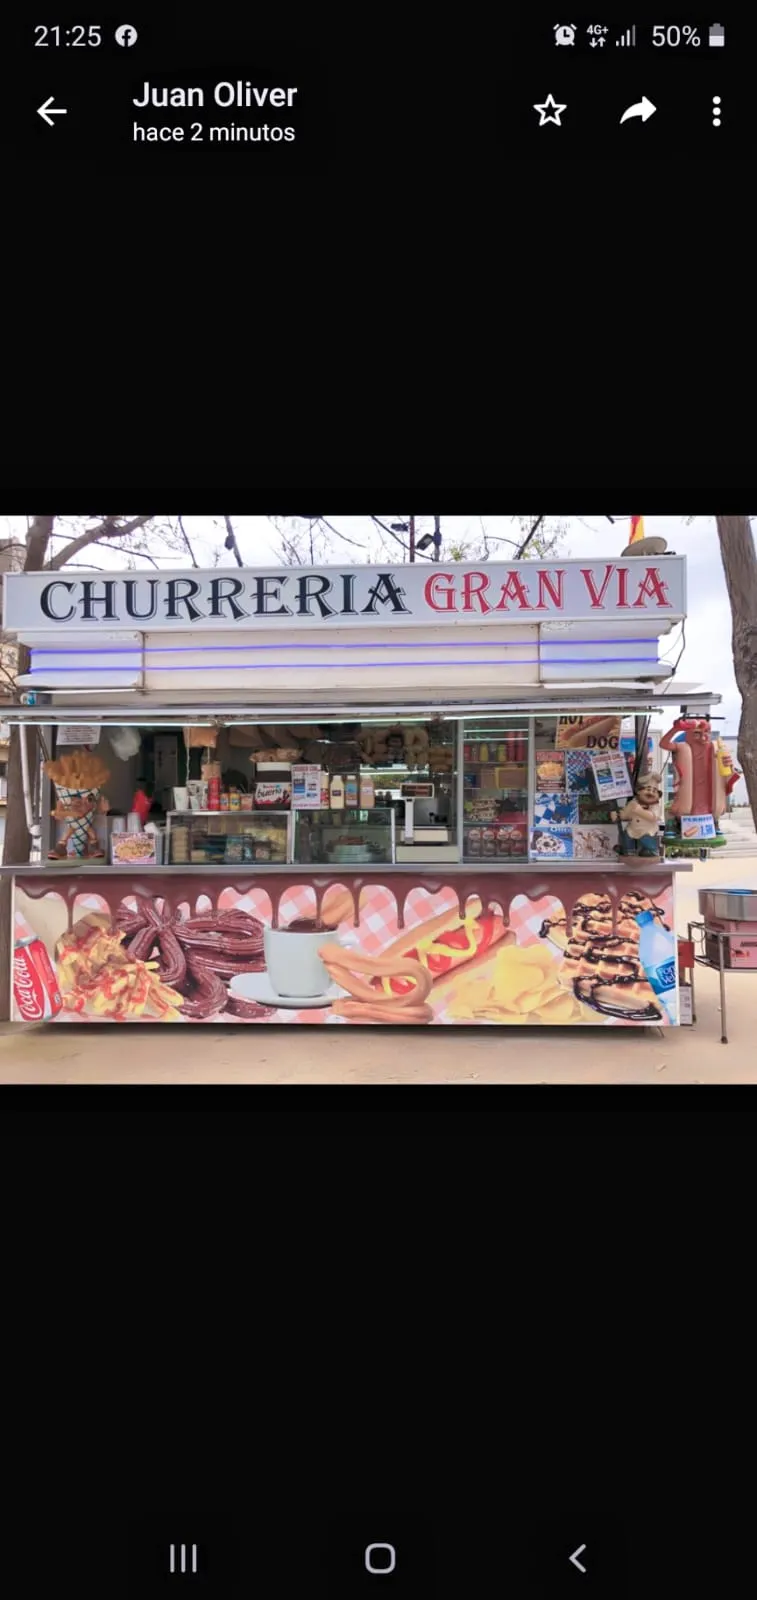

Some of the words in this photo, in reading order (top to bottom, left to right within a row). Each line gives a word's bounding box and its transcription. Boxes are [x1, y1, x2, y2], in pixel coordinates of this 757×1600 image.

[39, 573, 412, 622] CHURRERIA
[423, 570, 568, 616] GRAN
[579, 564, 673, 610] VIA
[586, 735, 619, 749] DOG
